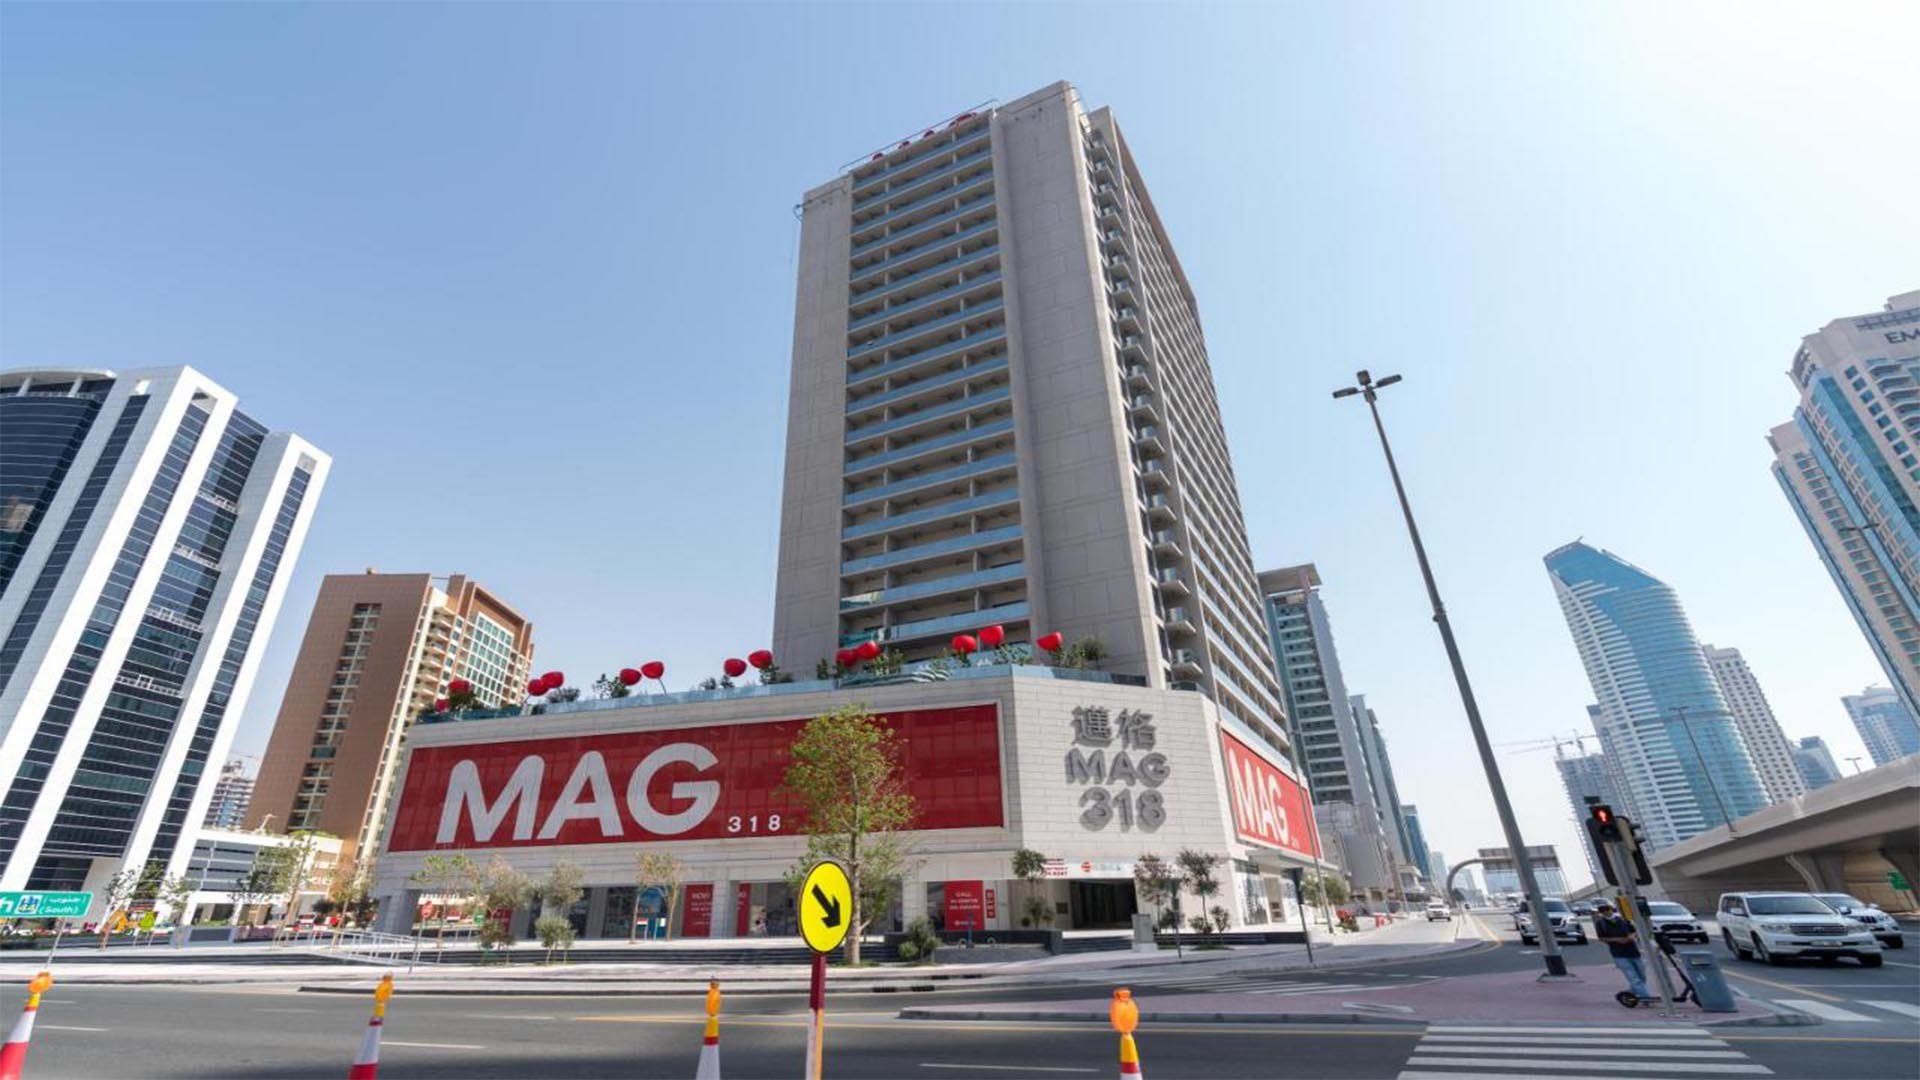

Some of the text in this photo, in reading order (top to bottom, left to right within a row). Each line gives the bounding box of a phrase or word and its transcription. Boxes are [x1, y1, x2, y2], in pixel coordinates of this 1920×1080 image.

[436, 742, 781, 844] MAG 318
[1064, 747, 1171, 788] MAG
[1229, 748, 1289, 845] MAG
[1078, 786, 1167, 833] 318
